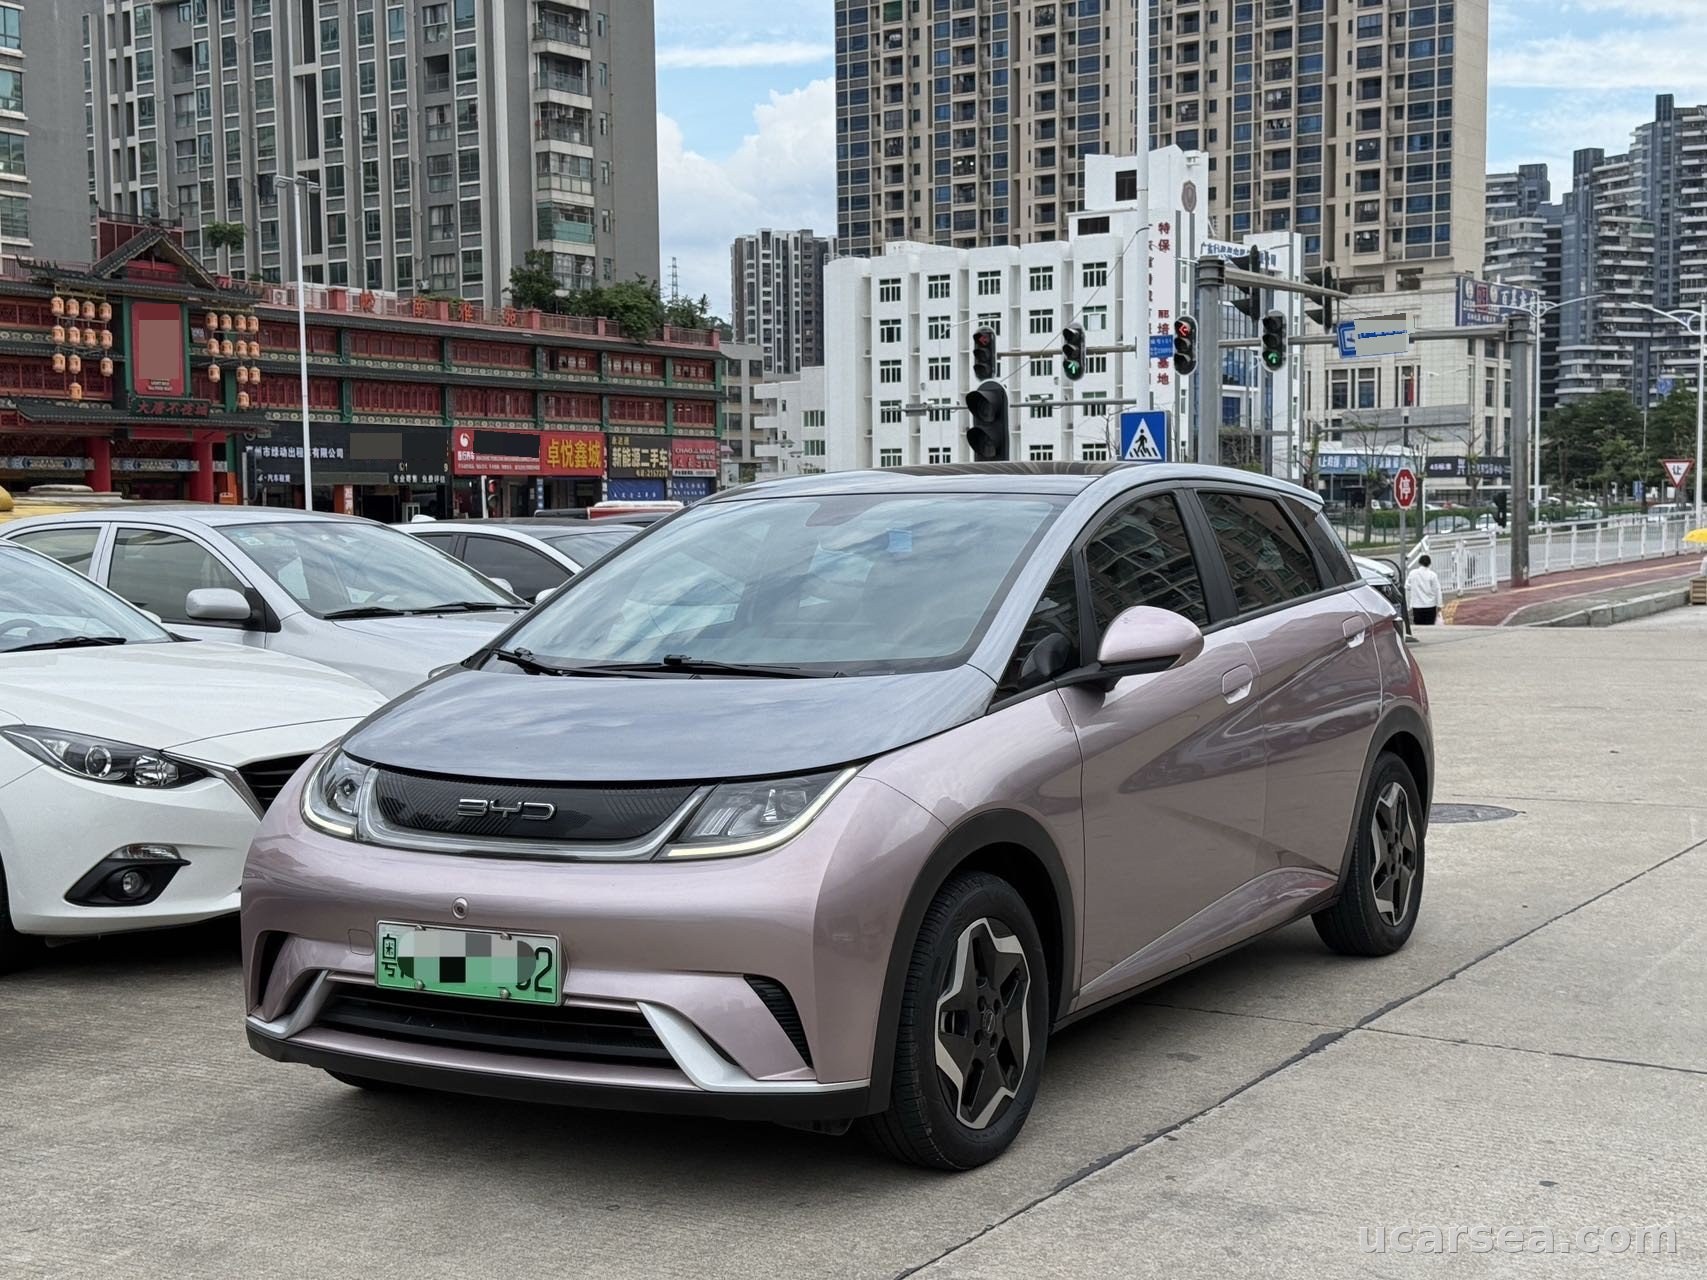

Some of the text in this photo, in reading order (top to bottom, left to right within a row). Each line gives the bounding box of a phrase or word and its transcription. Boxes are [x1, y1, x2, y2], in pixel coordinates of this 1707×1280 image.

[546, 438, 601, 469] 卓悦鑫城
[611, 446, 668, 468] 新能源二手车
[1399, 475, 1411, 501] 停
[456, 798, 556, 821] BYD
